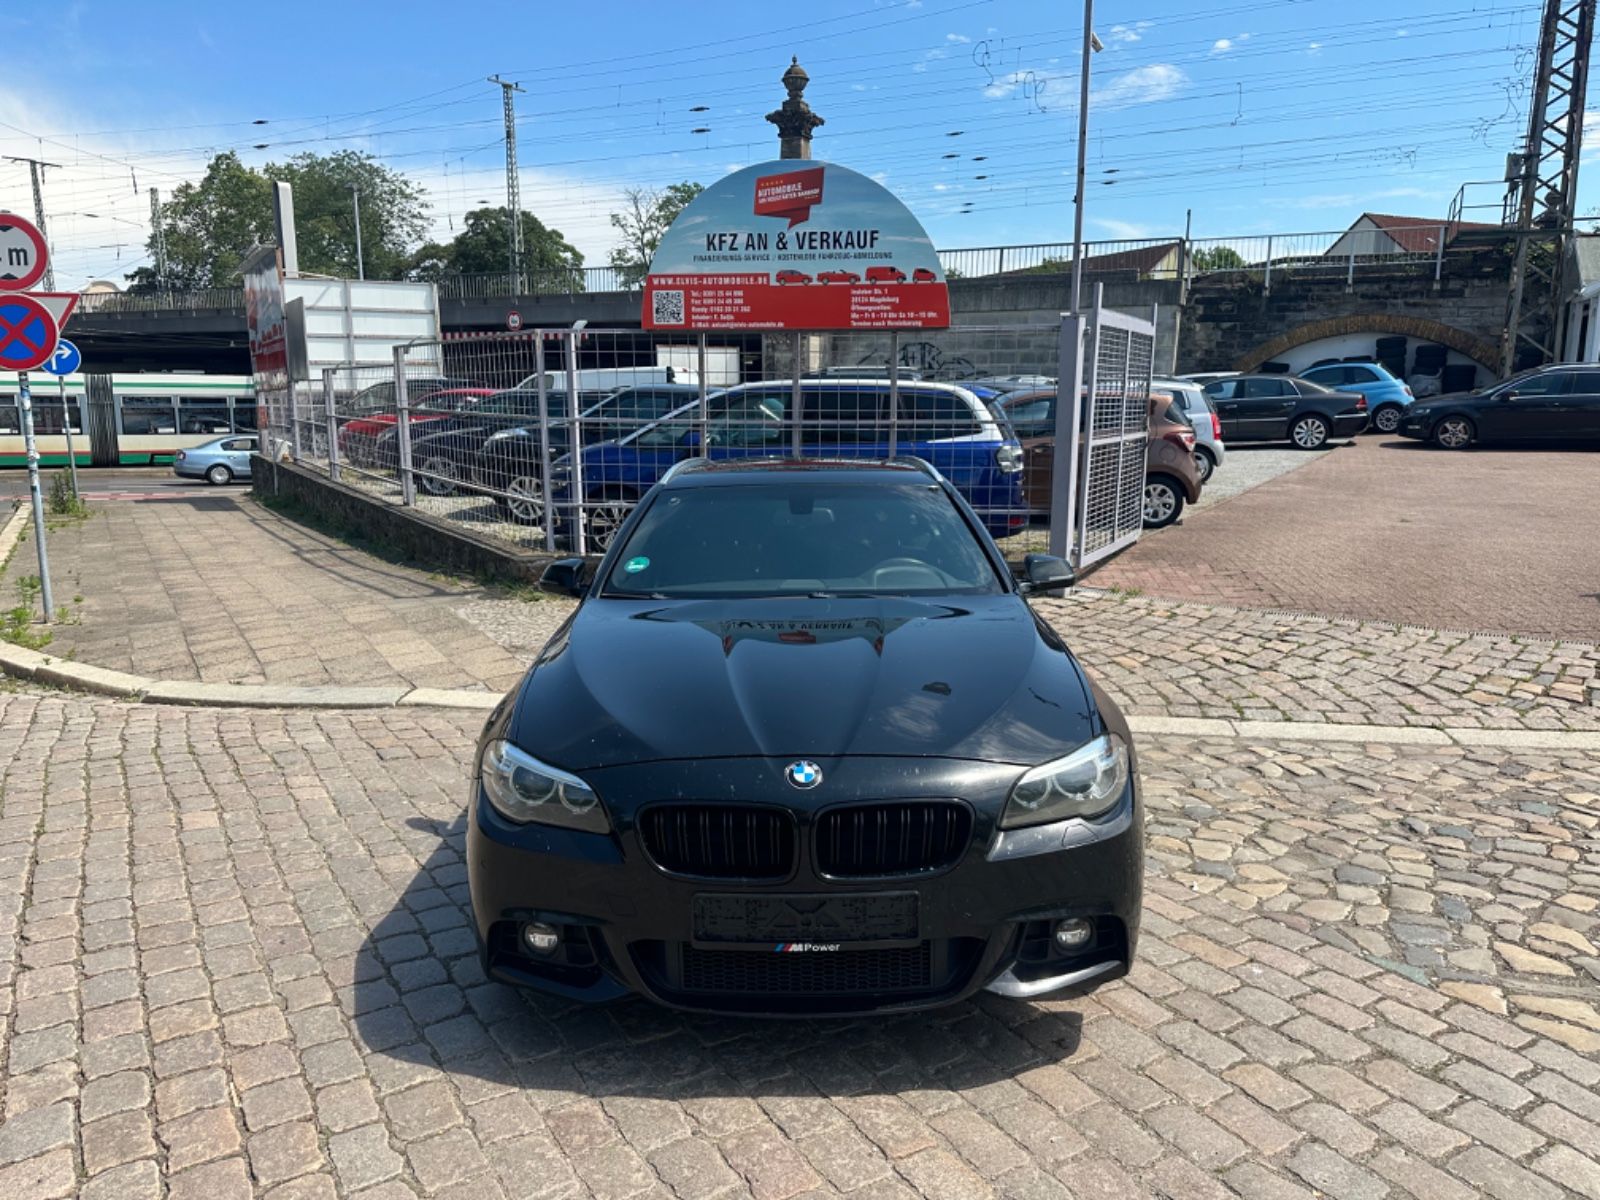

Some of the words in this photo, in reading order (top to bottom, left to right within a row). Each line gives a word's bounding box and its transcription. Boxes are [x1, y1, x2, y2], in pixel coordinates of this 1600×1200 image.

[758, 182, 802, 197] AUTOMOBILE
[706, 233, 738, 251] KFZ
[745, 232, 768, 251] AN
[775, 231, 788, 250] &
[795, 230, 880, 250] VERKAUF
